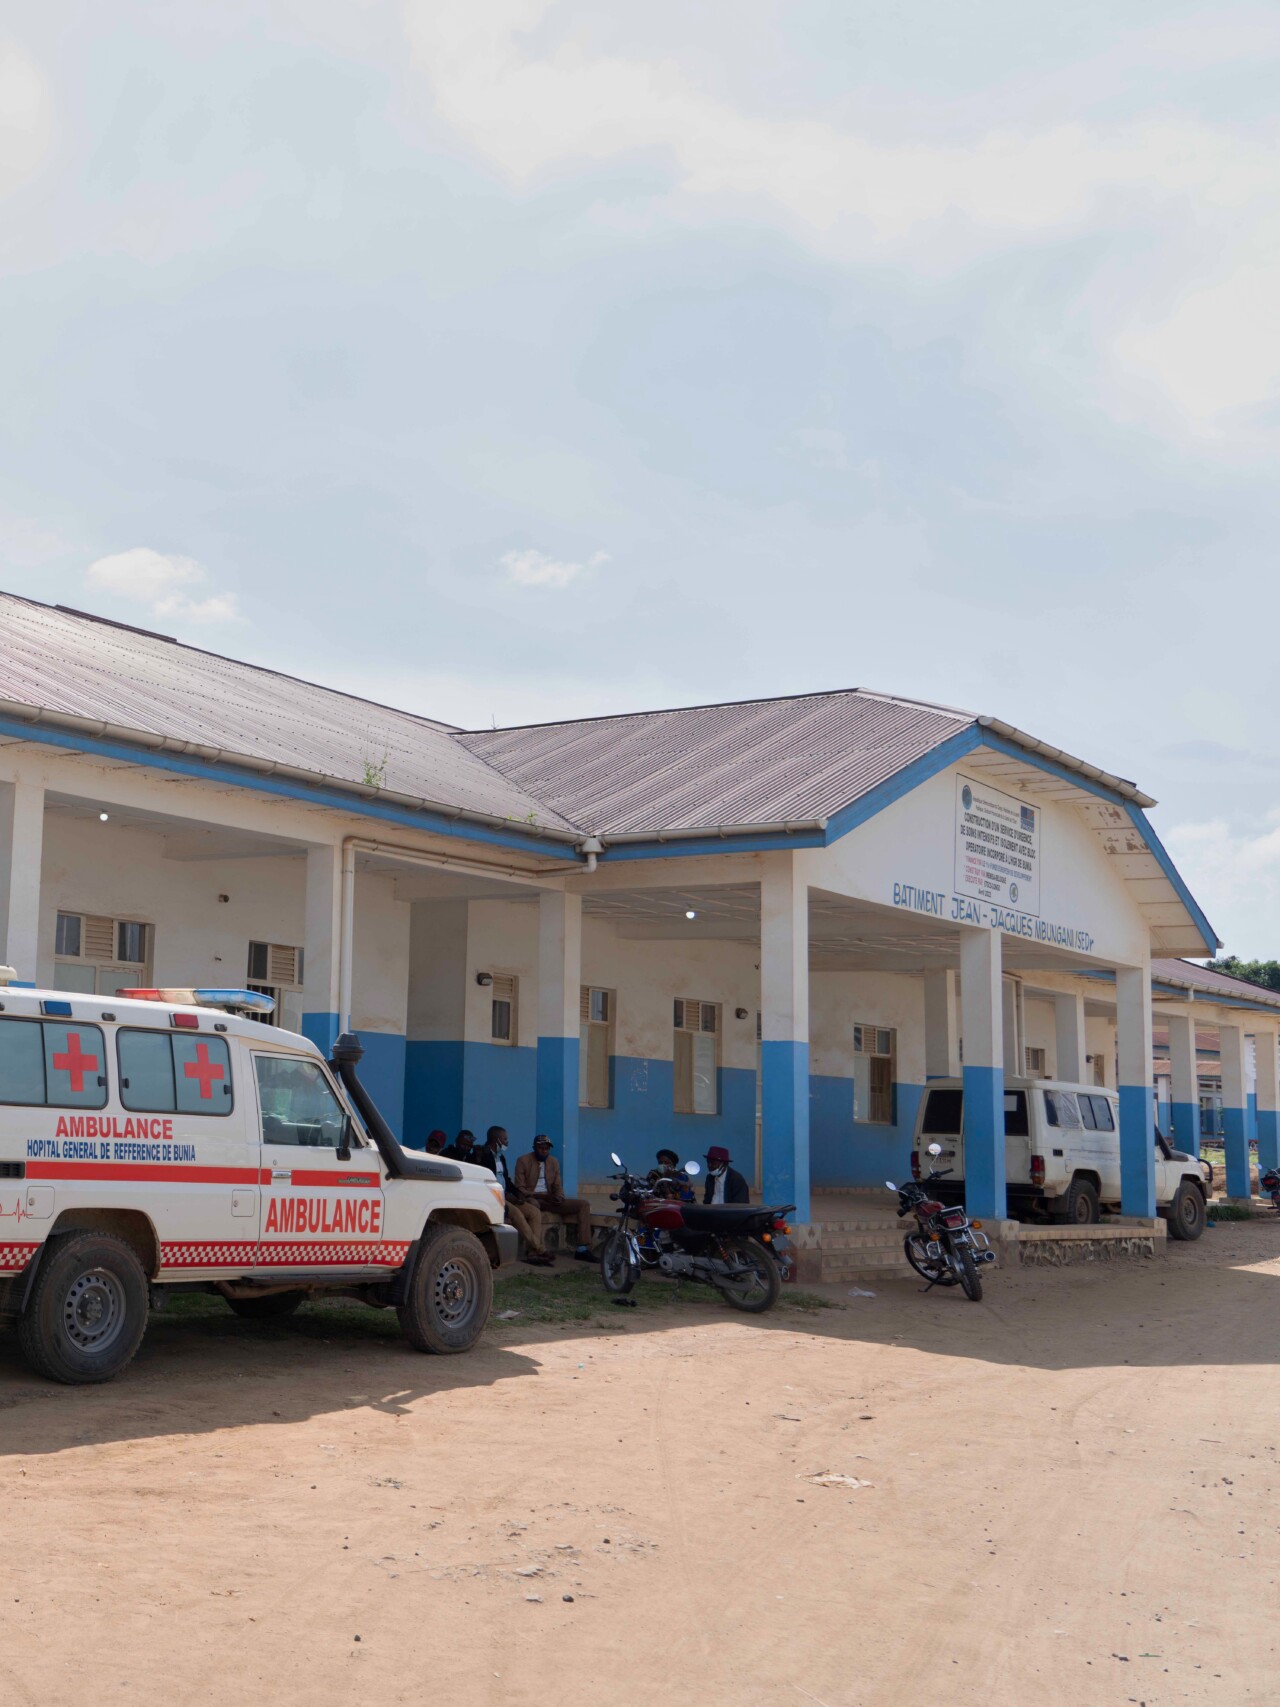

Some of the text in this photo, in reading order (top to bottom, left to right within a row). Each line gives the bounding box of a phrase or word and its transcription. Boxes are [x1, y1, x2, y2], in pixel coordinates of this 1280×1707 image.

[893, 883, 945, 915] BATIMENT
[952, 897, 980, 923] JEAN
[991, 908, 1032, 937] JACQUES
[55, 1116, 174, 1140] AMBULANCE
[27, 1139, 196, 1162] HOPITAL GENERAL DE REFFERENCE DE BUNIA
[264, 1197, 381, 1234] AMBULANCE
